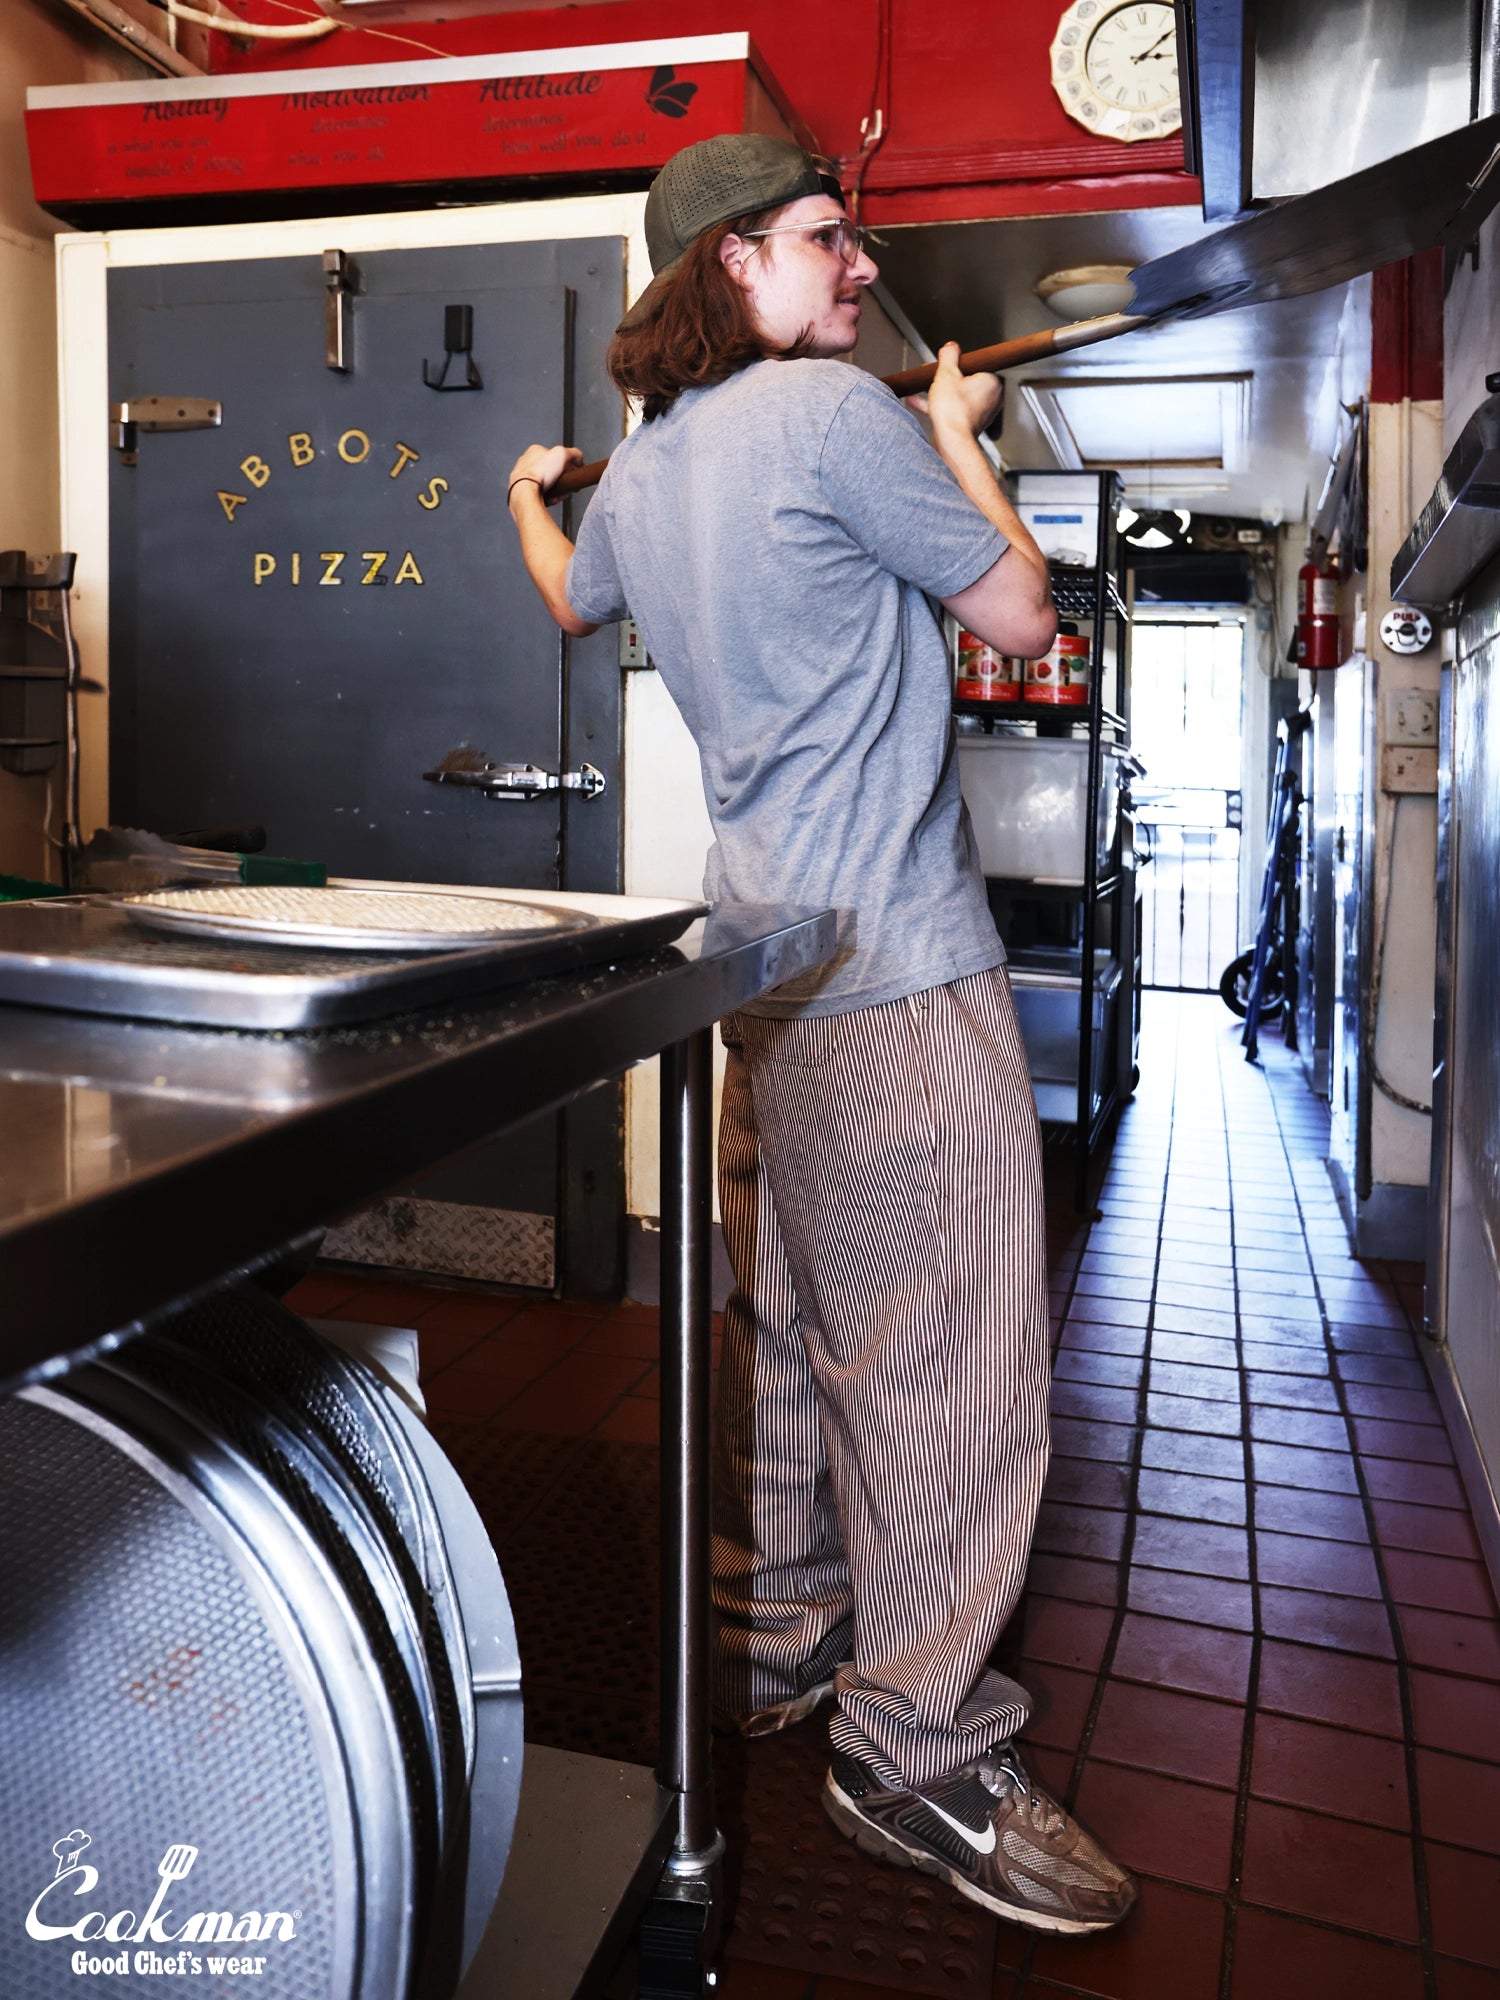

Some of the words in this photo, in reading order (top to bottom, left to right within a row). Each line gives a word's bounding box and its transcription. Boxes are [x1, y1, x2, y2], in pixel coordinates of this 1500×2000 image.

[479, 72, 604, 103] Attitude
[482, 113, 564, 133] determines
[573, 134, 602, 153] you
[216, 428, 450, 523] ABBOTS
[253, 550, 425, 587] PIZZA
